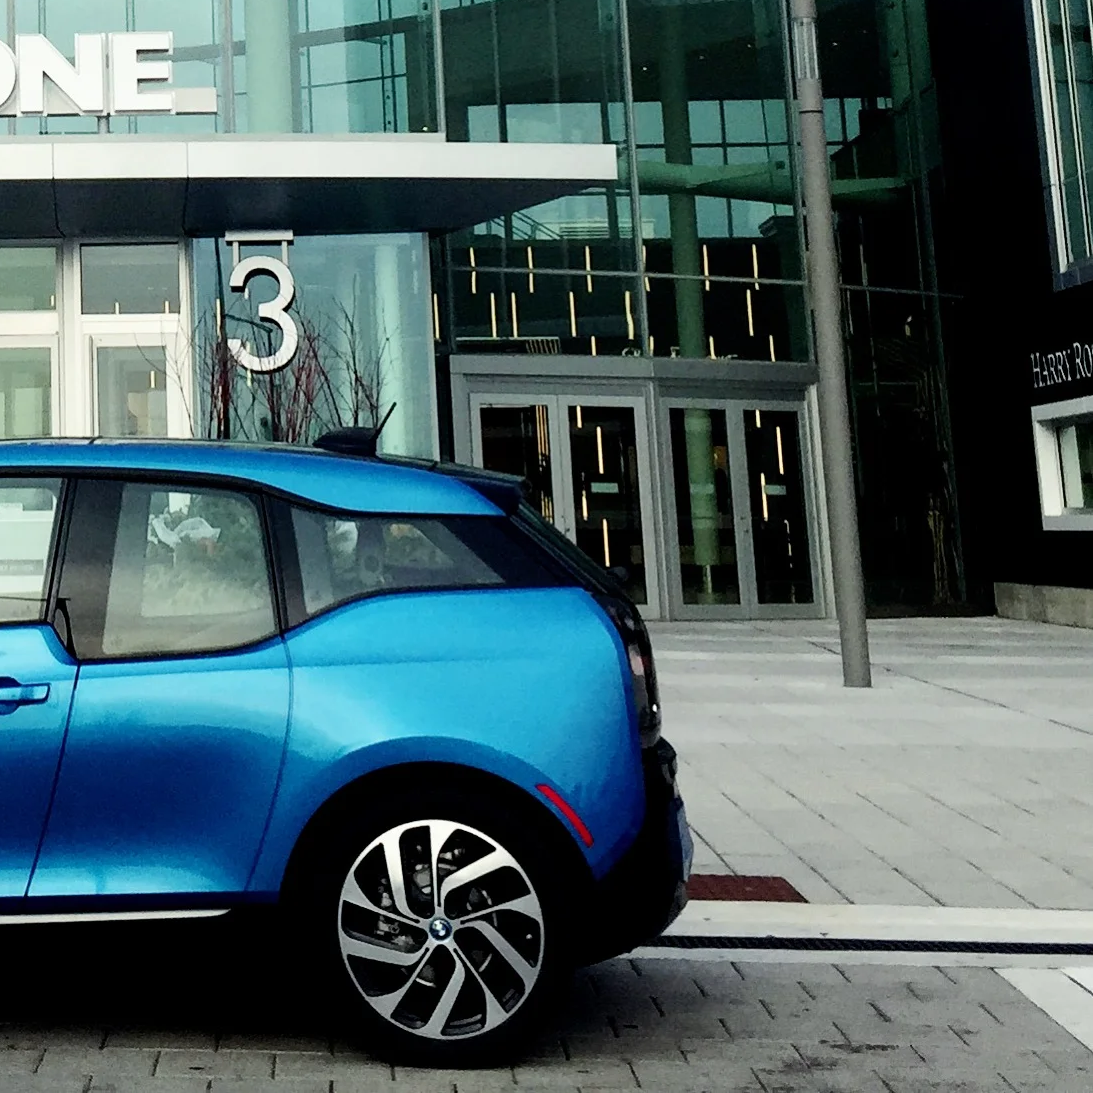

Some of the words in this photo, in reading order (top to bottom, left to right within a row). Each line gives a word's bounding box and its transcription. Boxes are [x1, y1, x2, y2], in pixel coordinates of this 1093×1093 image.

[227, 255, 300, 373] 3
[1030, 349, 1072, 388] HARRY
[1072, 342, 1093, 379] RO
